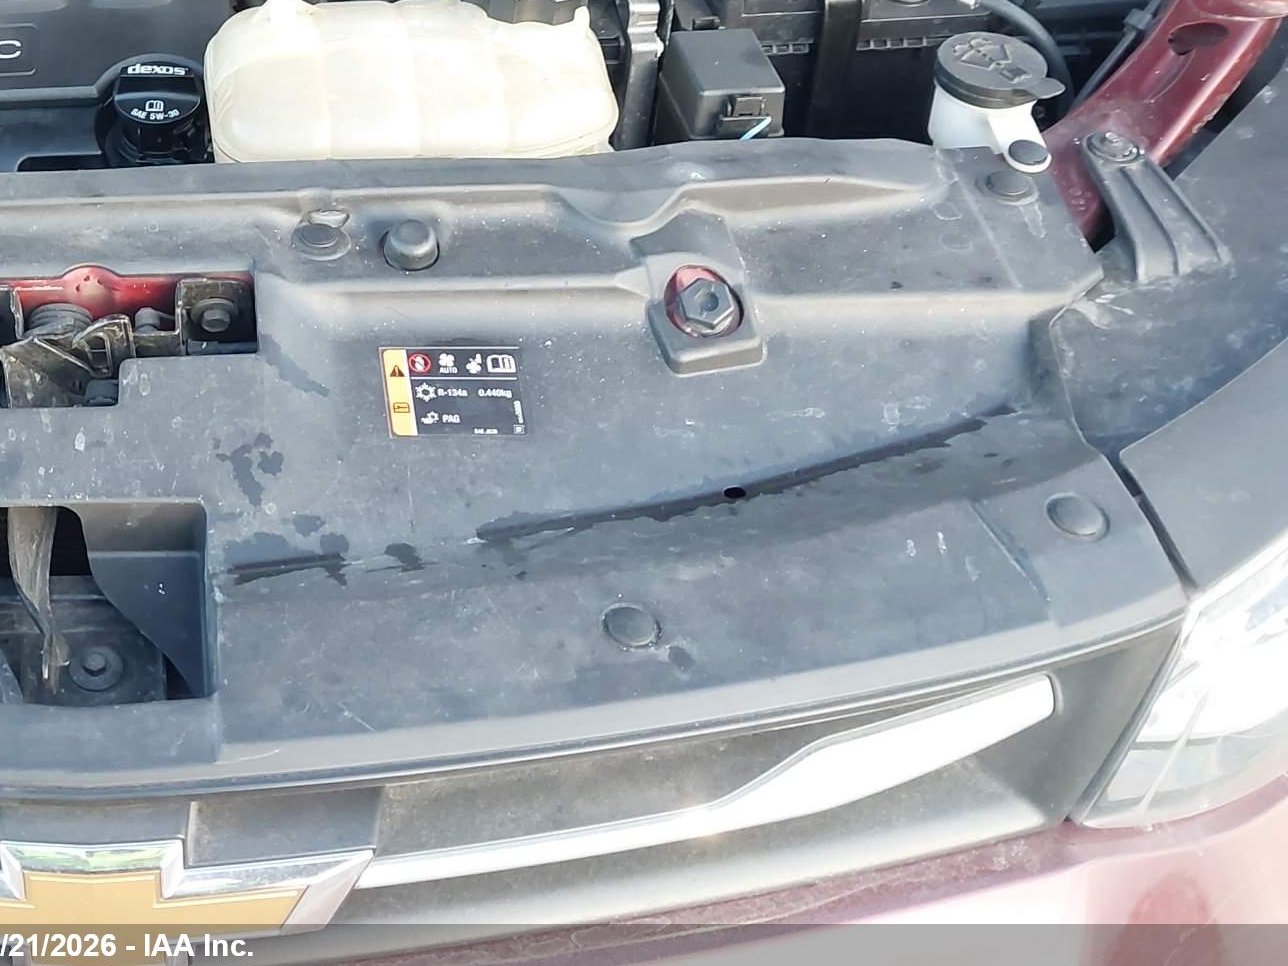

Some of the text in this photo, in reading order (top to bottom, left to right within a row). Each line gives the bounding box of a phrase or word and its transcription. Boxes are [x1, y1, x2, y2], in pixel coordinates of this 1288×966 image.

[127, 63, 186, 75] dexos
[130, 108, 180, 120] SAE 5W-30
[438, 388, 468, 396] R-134a
[442, 414, 460, 423] PAG
